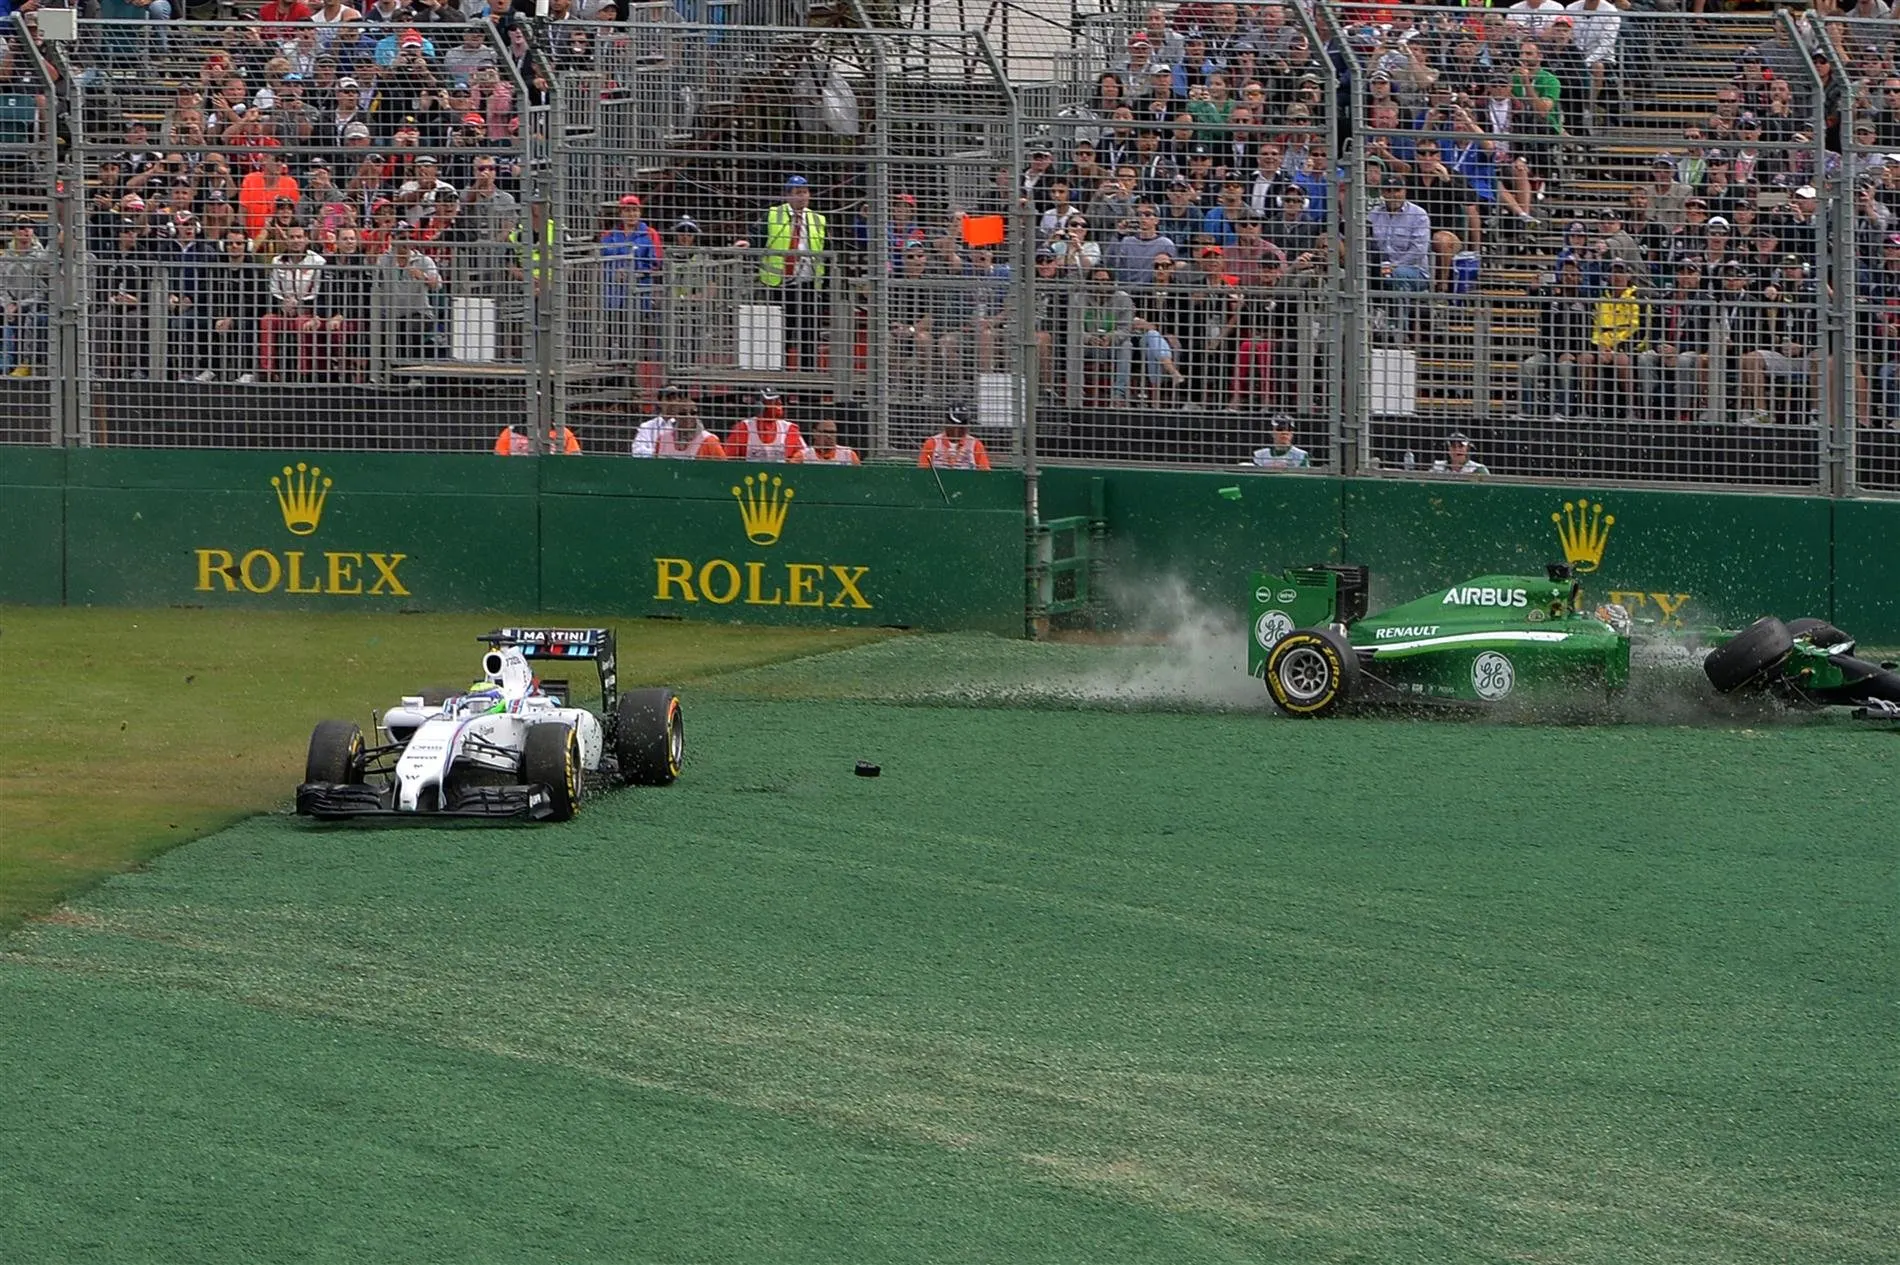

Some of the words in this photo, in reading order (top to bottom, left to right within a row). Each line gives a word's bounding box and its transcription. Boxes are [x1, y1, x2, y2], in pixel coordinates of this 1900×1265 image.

[194, 549, 411, 595] ROLEX
[653, 557, 873, 609] ROLEX
[1442, 587, 1528, 608] AIRBUS
[1376, 625, 1440, 639] RENAULT
[1322, 646, 1340, 689] ZERO
